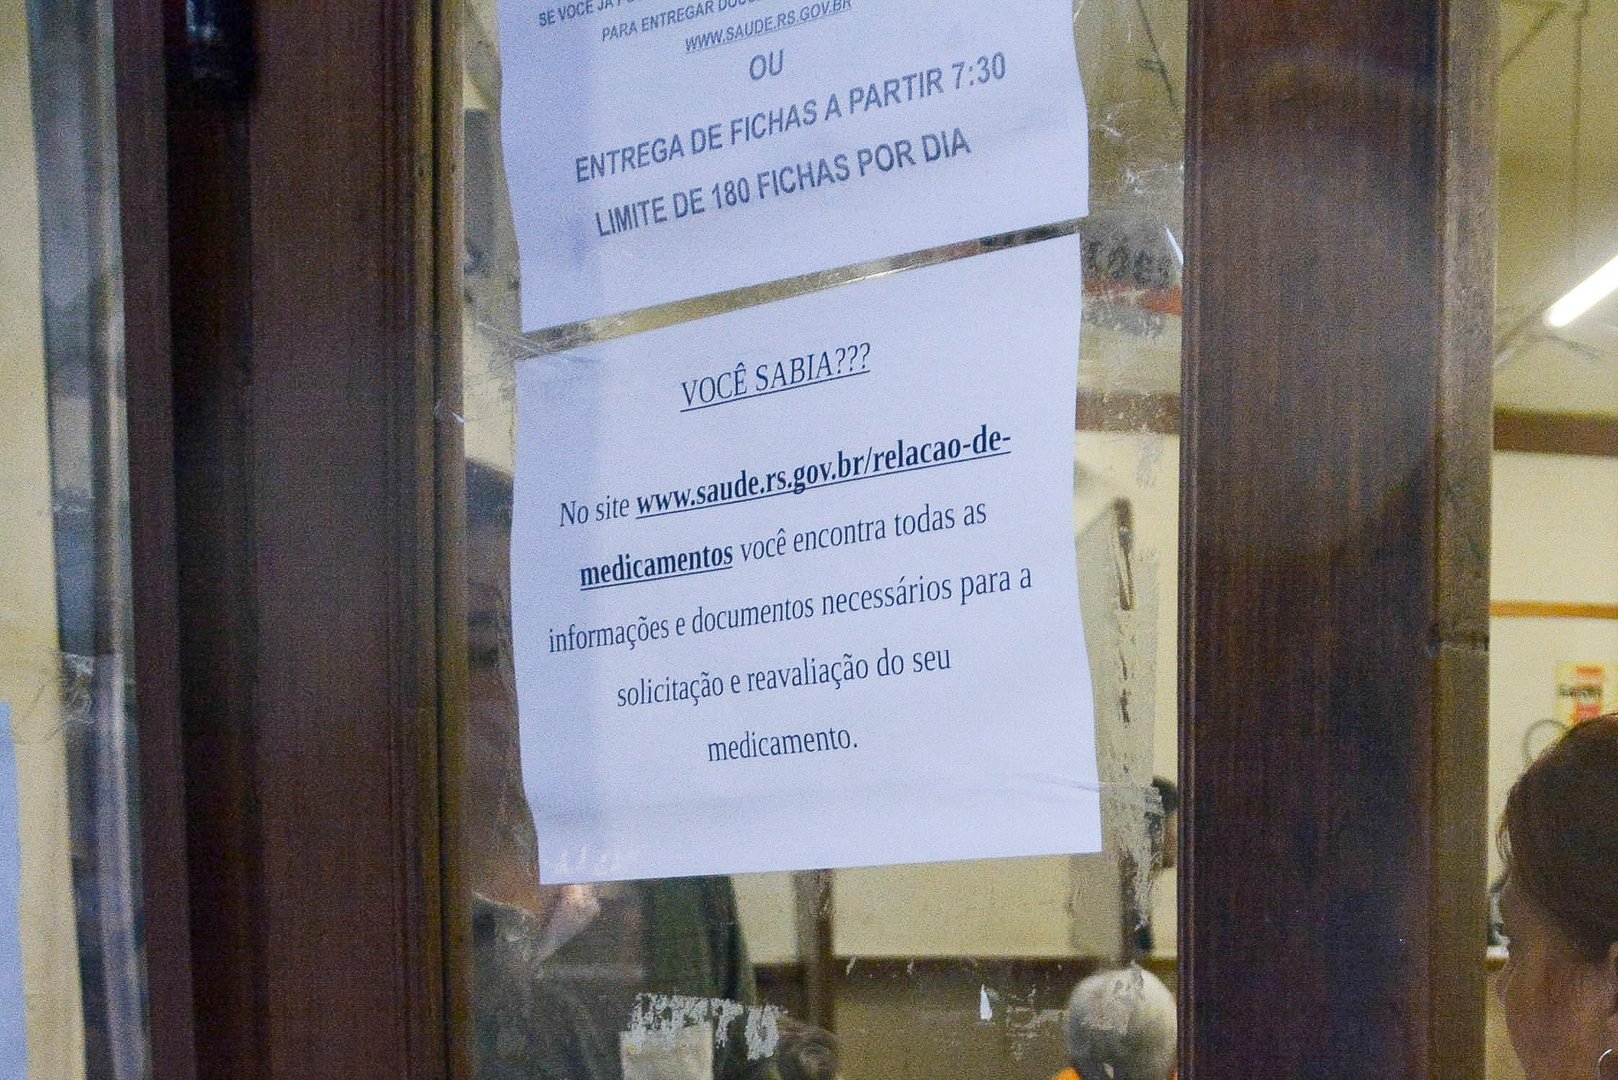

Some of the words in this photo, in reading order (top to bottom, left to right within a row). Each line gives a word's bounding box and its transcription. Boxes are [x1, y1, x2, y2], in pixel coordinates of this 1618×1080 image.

[538, 10, 556, 27] SE
[601, 20, 638, 42] PARA
[641, 2, 714, 32] ENTREGAR
[749, 50, 783, 80] OU
[576, 134, 684, 183] ENTREGA
[691, 124, 723, 155] DE
[731, 100, 817, 145] FICHAS
[825, 94, 842, 121] A
[850, 68, 943, 114] PARTIR
[952, 52, 1005, 89] 7:30
[595, 196, 668, 237] LIMITE
[673, 188, 705, 219] DE
[712, 177, 750, 209] 180
[757, 154, 850, 199] FICHAS
[857, 140, 916, 177] POR
[921, 128, 971, 163] DIA
[681, 362, 747, 406] VOCÊ
[756, 342, 871, 391] SABIA???
[560, 501, 589, 527] No
[596, 495, 630, 521] site
[636, 423, 1011, 515] www.saude.rs.gov.br/relacao-de-
[580, 541, 733, 586] medicamentos
[740, 528, 786, 561] você
[793, 519, 886, 553] encontra
[894, 503, 955, 537] todas
[963, 503, 987, 526] as
[549, 616, 669, 653] informações
[676, 617, 685, 636] e
[692, 598, 814, 634] documentos
[822, 575, 952, 615] necessários
[961, 571, 1010, 606] para
[1020, 568, 1031, 589] a
[618, 671, 724, 707] solicitação
[730, 675, 741, 694] e
[747, 653, 869, 692] reavaliação
[877, 647, 904, 677] do
[913, 649, 951, 673] seu
[708, 728, 857, 762] medicamento.
